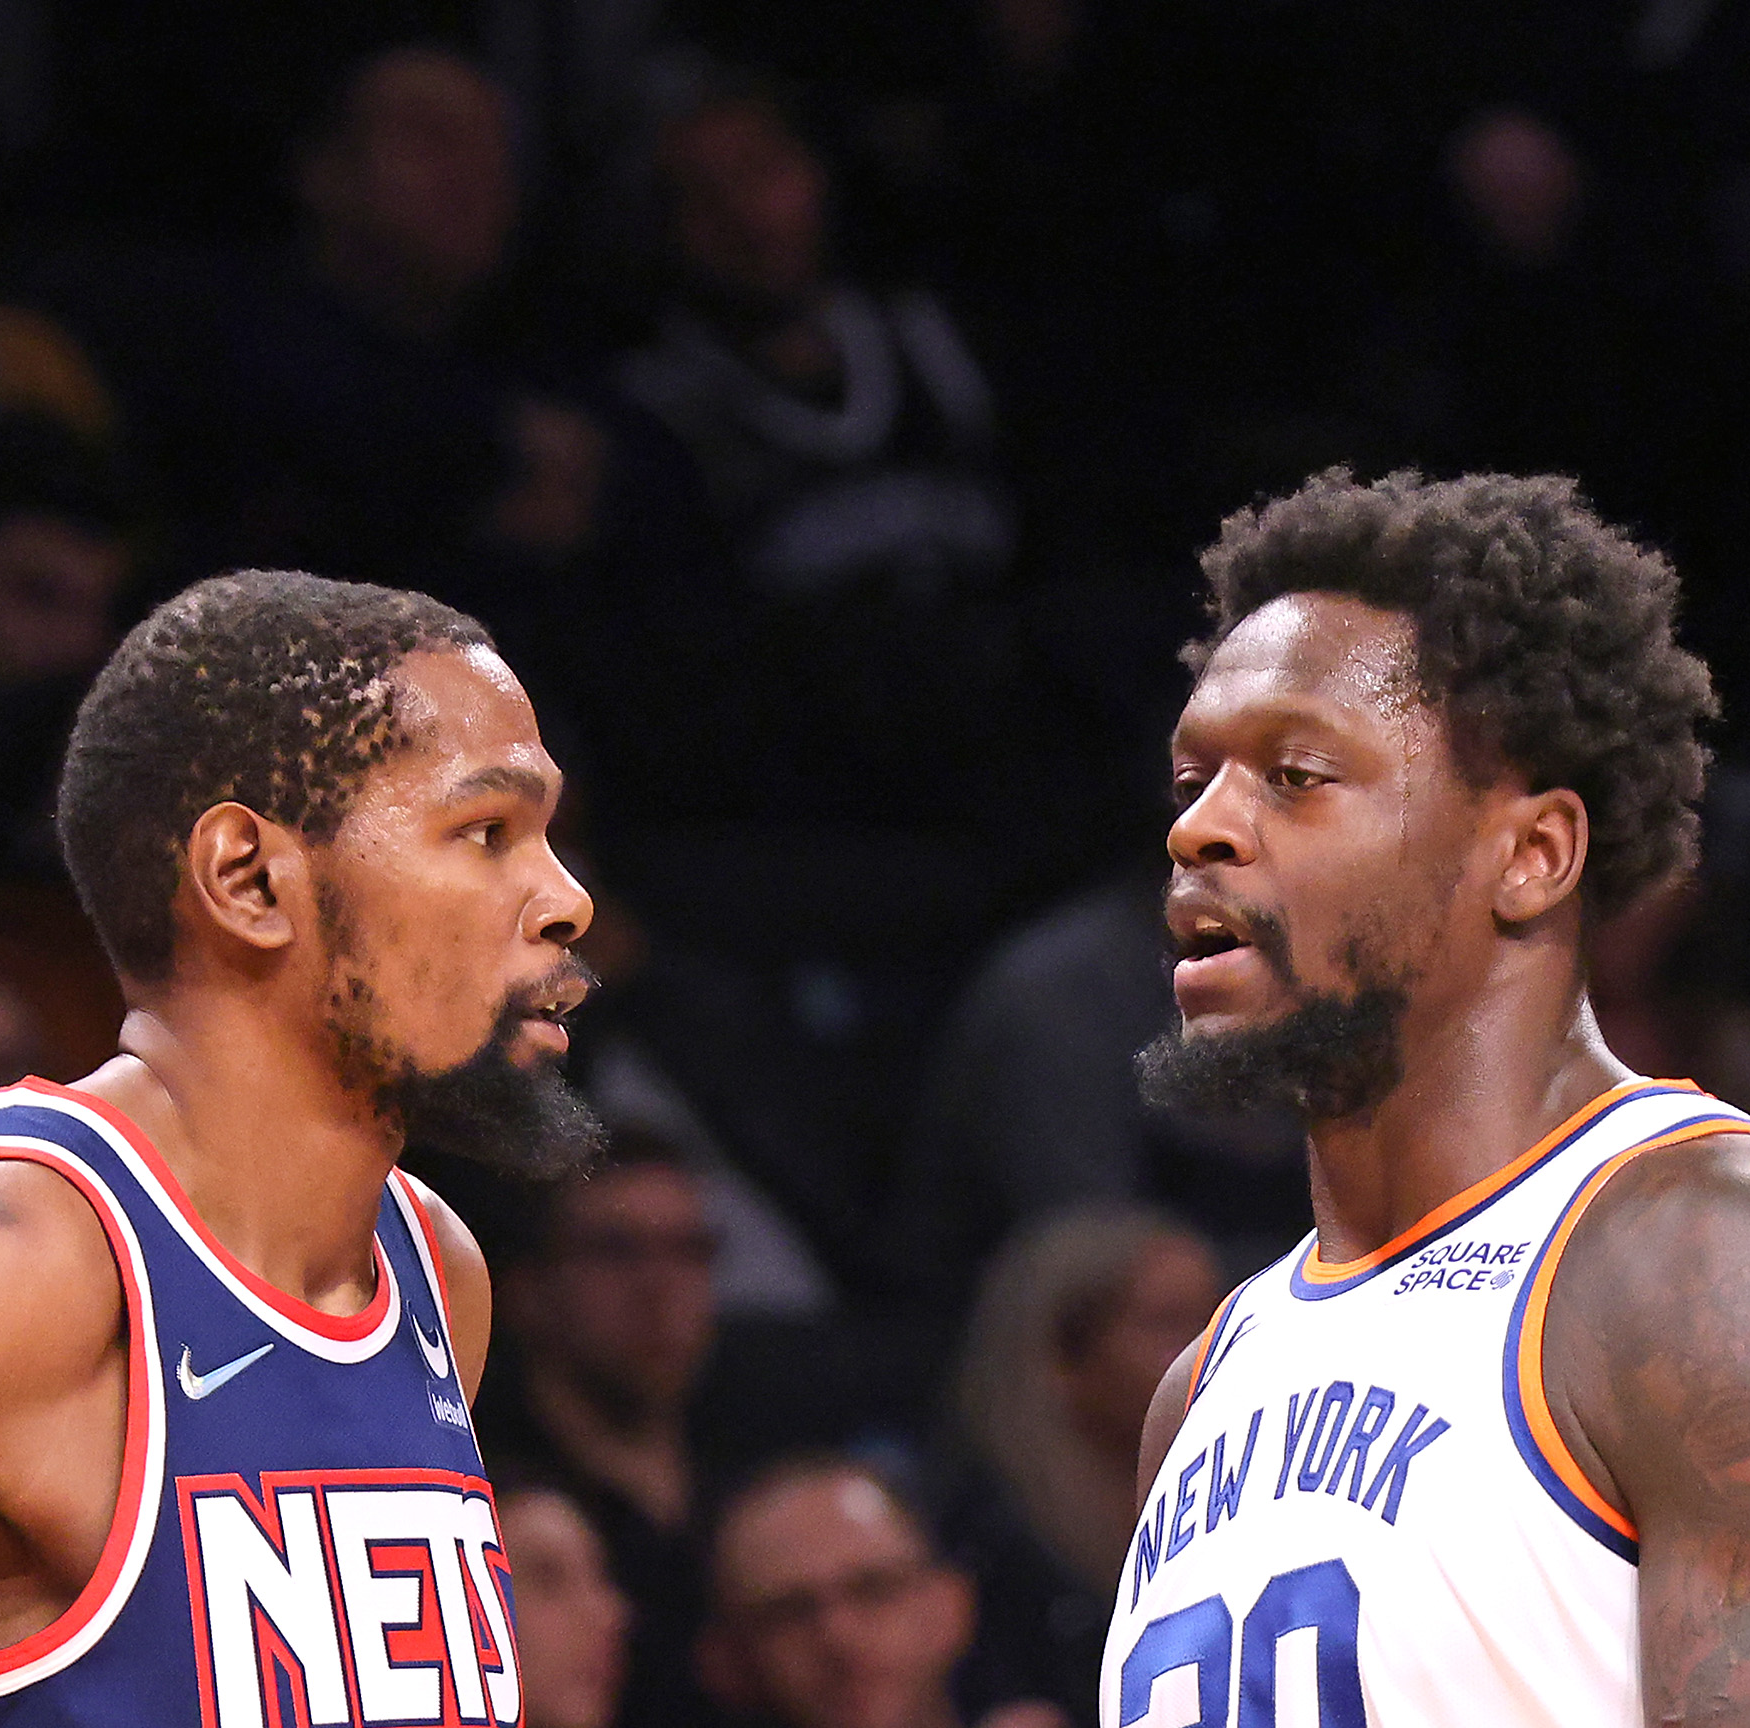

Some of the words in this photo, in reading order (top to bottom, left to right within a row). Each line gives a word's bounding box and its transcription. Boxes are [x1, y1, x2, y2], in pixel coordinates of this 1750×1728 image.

[1411, 1241, 1531, 1268] SQUARE
[1393, 1268, 1492, 1295] SPACE
[1131, 1406, 1264, 1614] NEW
[1274, 1380, 1452, 1527] YORK
